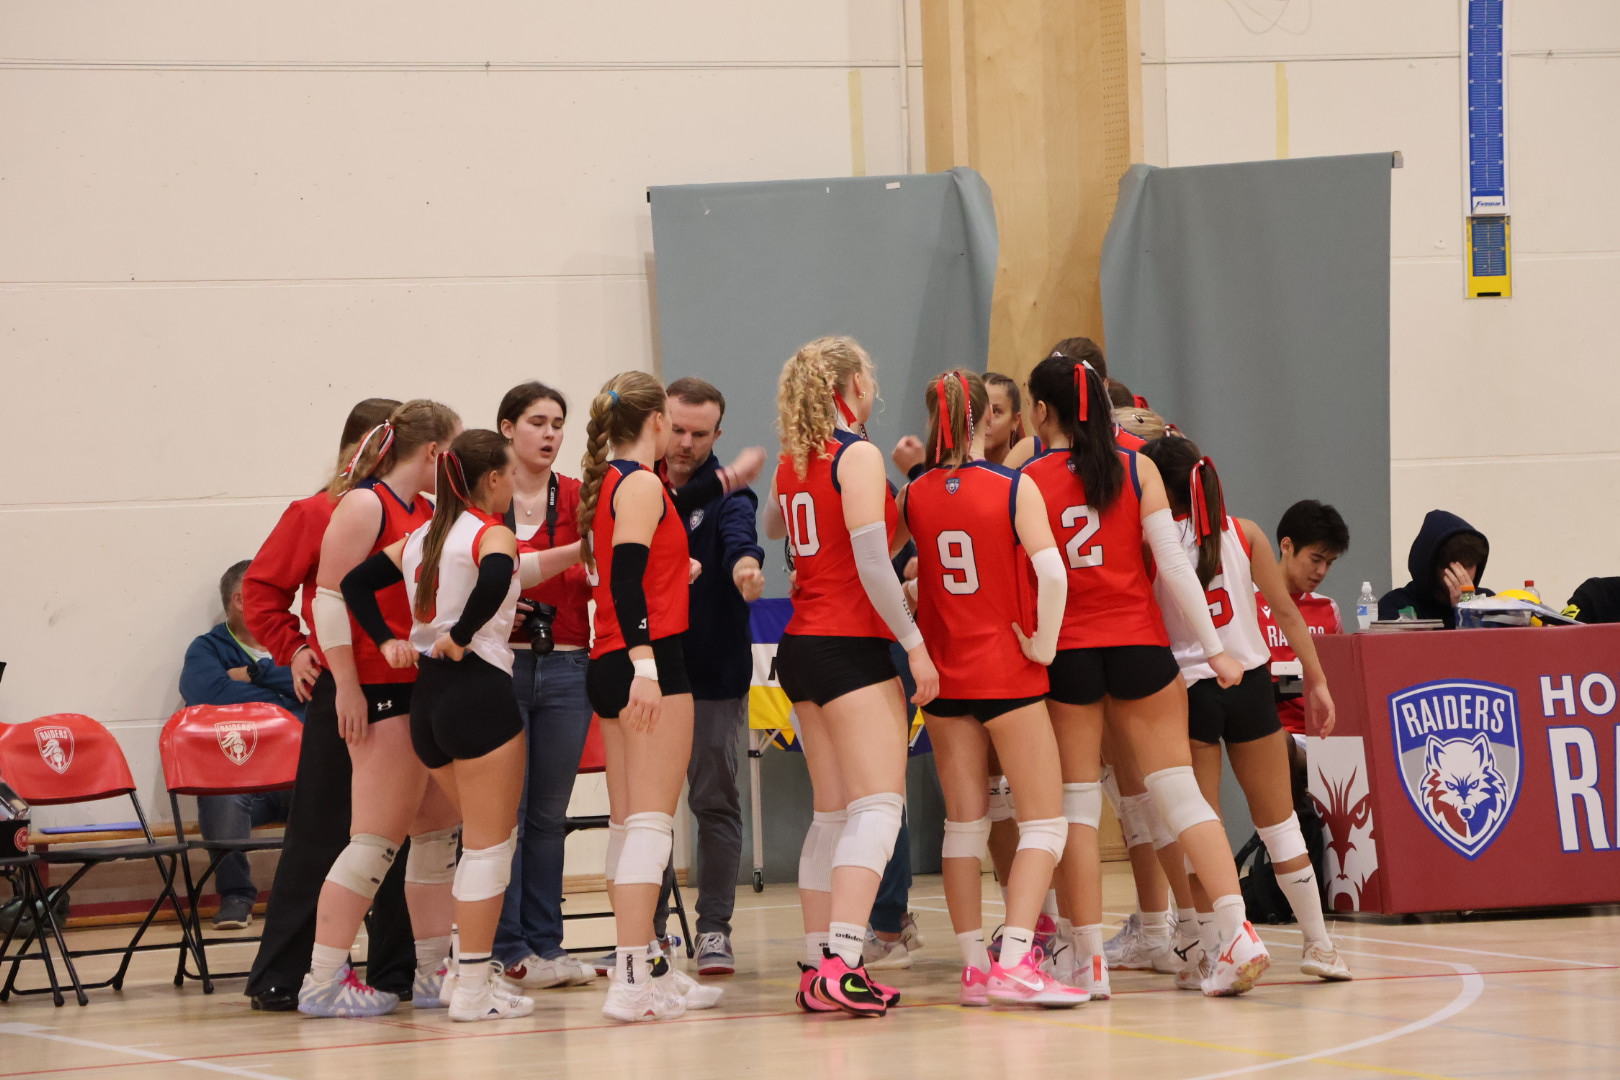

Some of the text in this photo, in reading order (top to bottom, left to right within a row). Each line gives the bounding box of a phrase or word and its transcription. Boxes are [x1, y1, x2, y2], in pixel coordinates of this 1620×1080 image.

[778, 491, 820, 557] 10
[1060, 504, 1104, 570] 2
[936, 529, 980, 595] 9
[39, 729, 68, 741] RAIDERS
[1401, 694, 1505, 738] RAIDERS
[1547, 725, 1620, 851] R
